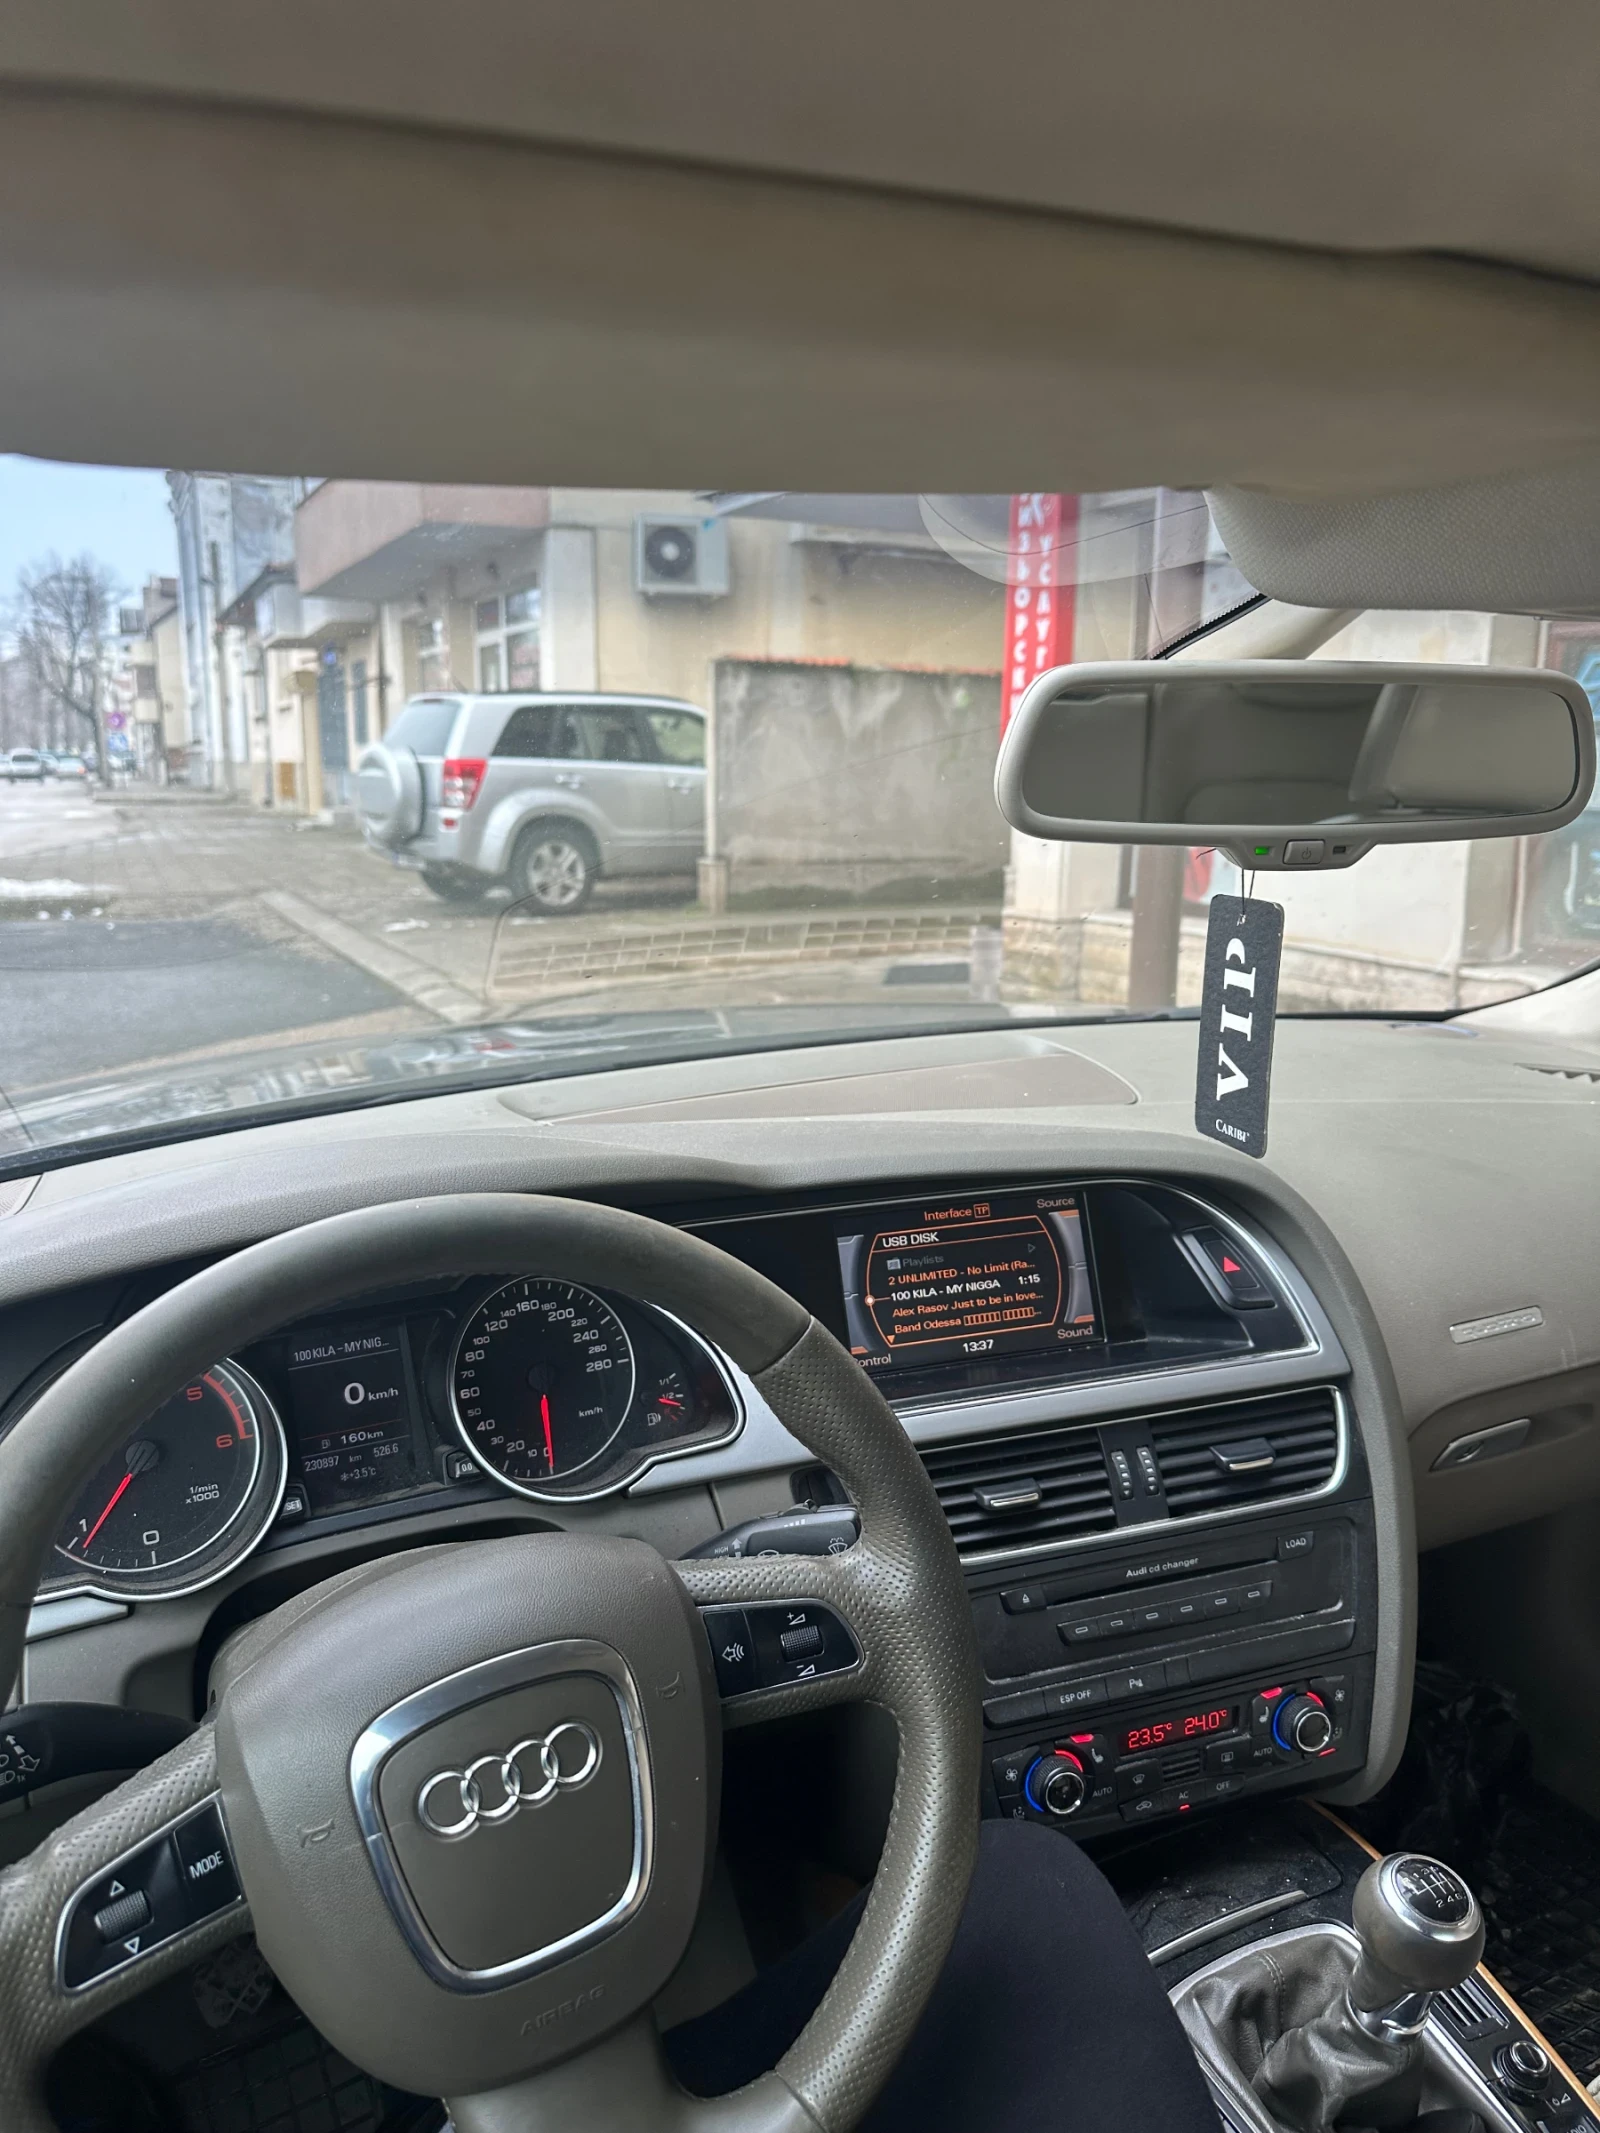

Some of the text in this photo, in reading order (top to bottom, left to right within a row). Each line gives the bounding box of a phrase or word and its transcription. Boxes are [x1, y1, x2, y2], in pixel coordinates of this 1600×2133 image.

[1032, 533, 1053, 680] УСЛУГ
[1216, 938, 1256, 1101] VIP
[1037, 1197, 1075, 1209] Source
[924, 1206, 989, 1222] Interface TP
[882, 1232, 940, 1248] USB DISK
[902, 1255, 945, 1268] Playlists
[888, 1277, 896, 1286] 2
[898, 1269, 958, 1284] UNLIMITED
[967, 1266, 982, 1276] No
[984, 1263, 1010, 1274] Limit
[890, 1292, 911, 1302] 100
[912, 1287, 938, 1299] KILA
[946, 1284, 964, 1295] MY
[966, 1279, 1001, 1292] NIGGA
[1018, 1274, 1041, 1285] 1:15
[516, 1300, 540, 1312] 160
[541, 1302, 557, 1311] 180
[892, 1308, 915, 1318] Alex
[917, 1303, 949, 1315] Rasov
[951, 1299, 974, 1310] Just
[976, 1299, 987, 1307] to
[989, 1296, 1002, 1305] be
[1003, 1293, 1013, 1303] in
[500, 1309, 516, 1318] 140
[548, 1308, 575, 1322] 200
[484, 1319, 508, 1332] 120
[571, 1317, 588, 1327] 220
[894, 1317, 962, 1334] Band Odessa
[573, 1329, 599, 1343] 240
[1057, 1325, 1093, 1339] Sound
[473, 1336, 490, 1345] 100
[962, 1339, 994, 1353] 13:37
[294, 1350, 312, 1362] 100
[312, 1345, 336, 1359] KILA
[344, 1340, 362, 1353] MY
[588, 1344, 607, 1354] 260
[465, 1350, 485, 1362] 80
[856, 1353, 892, 1367] ontrol
[586, 1359, 612, 1372] 280
[460, 1370, 475, 1378] 70
[186, 1386, 202, 1401] 5
[344, 1382, 399, 1405] 0 km/h
[460, 1387, 480, 1399] 60
[467, 1408, 481, 1417] 50
[579, 1407, 603, 1417] km/h
[476, 1419, 495, 1431] 40
[215, 1434, 233, 1448] 6
[490, 1436, 504, 1445] 30
[506, 1440, 525, 1453] 20
[305, 1443, 399, 1472] 230897 km 526.6
[527, 1450, 538, 1458] 10
[461, 1462, 473, 1472] 0.0
[189, 1483, 218, 1494] 1/min
[286, 1499, 301, 1511] SET
[78, 1518, 87, 1532] 1
[143, 1530, 159, 1545] 0
[1285, 1537, 1307, 1549] LOAD
[1126, 1557, 1199, 1578] Audi cd changer
[1060, 1689, 1092, 1704] ESP OFF
[1253, 1747, 1273, 1757] AUTO
[1092, 1786, 1113, 1798] AUTO
[1216, 1780, 1231, 1791] OFF
[1178, 1791, 1189, 1800] AC
[190, 1850, 224, 1879] MODE
